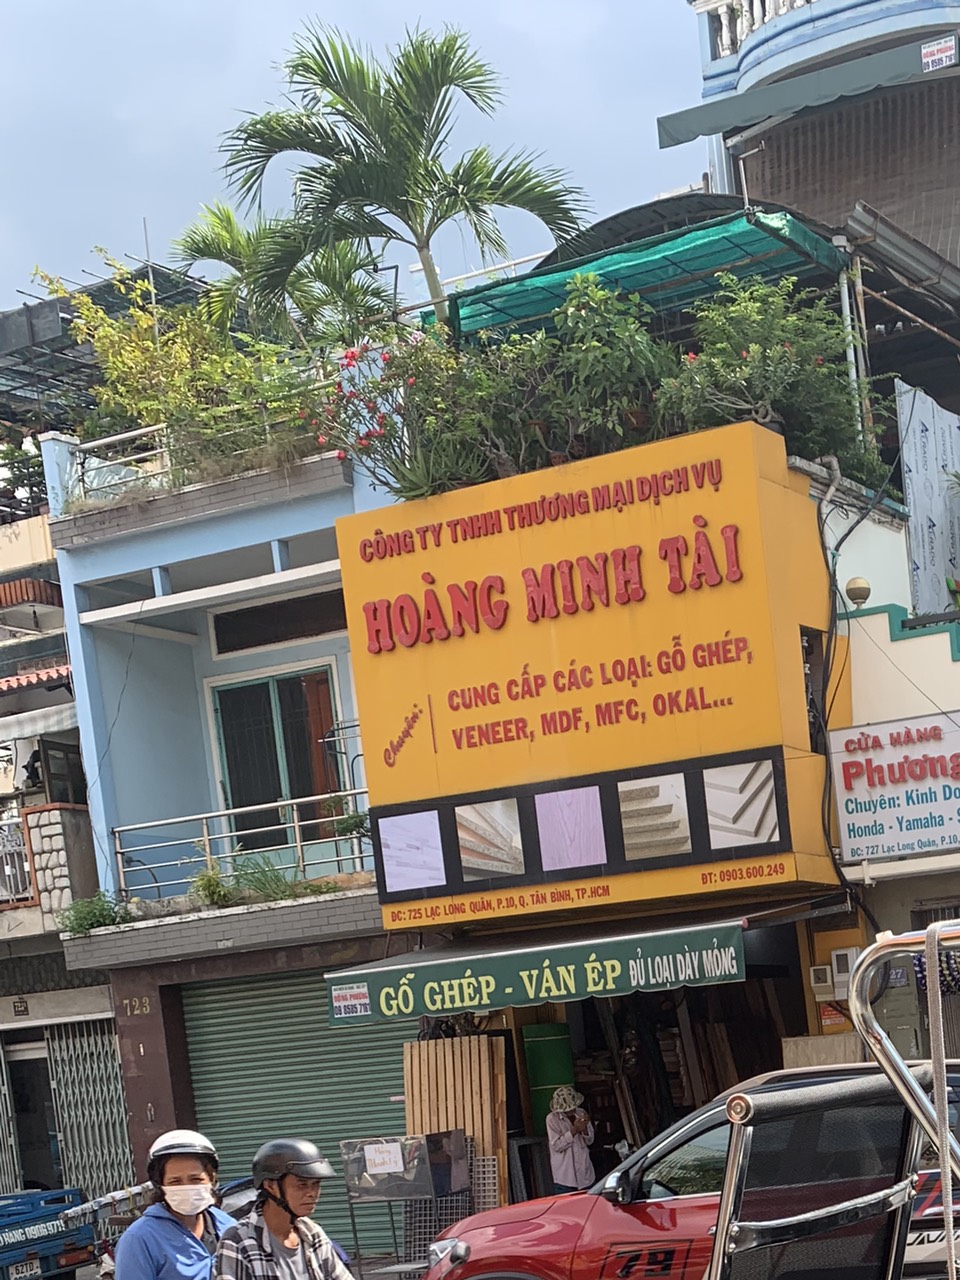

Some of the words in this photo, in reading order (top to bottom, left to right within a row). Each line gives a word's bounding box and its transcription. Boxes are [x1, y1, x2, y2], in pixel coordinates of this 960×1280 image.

[360, 528, 414, 562] CÔNG
[416, 522, 443, 550] TY
[447, 509, 502, 543] TNHH
[503, 490, 590, 531] THƯƠNG
[591, 479, 634, 512] MẠI
[636, 467, 689, 505] DỊCH
[691, 459, 722, 492] VỤ
[362, 572, 509, 654] HOÀNG
[522, 545, 646, 622] MINH
[658, 515, 743, 593] TÀI
[447, 683, 499, 712] CUNG
[506, 663, 547, 701] CẤP
[553, 659, 594, 692] CÁC
[600, 655, 653, 688] LOẠI:
[657, 634, 686, 674] GỖ
[692, 630, 753, 668] GHÉP,
[452, 717, 535, 750] VENEER,
[541, 707, 590, 736] MDF,
[595, 698, 646, 727] MFC,
[653, 687, 733, 716] OKAL...
[844, 732, 884, 754] CỬA
[889, 725, 944, 747] HÀNG
[845, 795, 901, 816] Chuyên:
[905, 787, 937, 806] Kinh
[847, 820, 885, 839] Honda
[896, 812, 945, 833] Yamaha
[851, 847, 864, 858] ĐC:
[866, 844, 879, 856] 727
[882, 844, 895, 855] Lạc
[898, 841, 915, 852] Long
[917, 837, 939, 849] Quân,
[941, 834, 960, 846] P.10,
[701, 872, 717, 885] ĐT:
[719, 863, 785, 882] 0903.600.249
[391, 911, 405, 922] ĐC:
[408, 908, 422, 920] 725
[425, 906, 441, 921] LẠC
[444, 903, 466, 915] LONG
[469, 897, 495, 913] QUÂN,
[497, 896, 518, 910] P.10,
[519, 895, 528, 908] Q.
[530, 890, 547, 905] TÂN
[551, 887, 574, 903] BÌNH,
[575, 885, 610, 900] TP.HCM
[379, 973, 415, 1016] GỖ
[424, 968, 496, 1011] GHÉP
[519, 959, 575, 999] VÁN
[584, 953, 621, 992] ÉP
[629, 948, 645, 987] ĐỦ
[648, 954, 675, 988] LOẠI
[676, 945, 699, 981] DÀY
[702, 938, 738, 977] MỎNG
[123, 997, 150, 1016] 723
[15, 1261, 34, 1275] 62TD
[616, 1248, 676, 1278] 79
